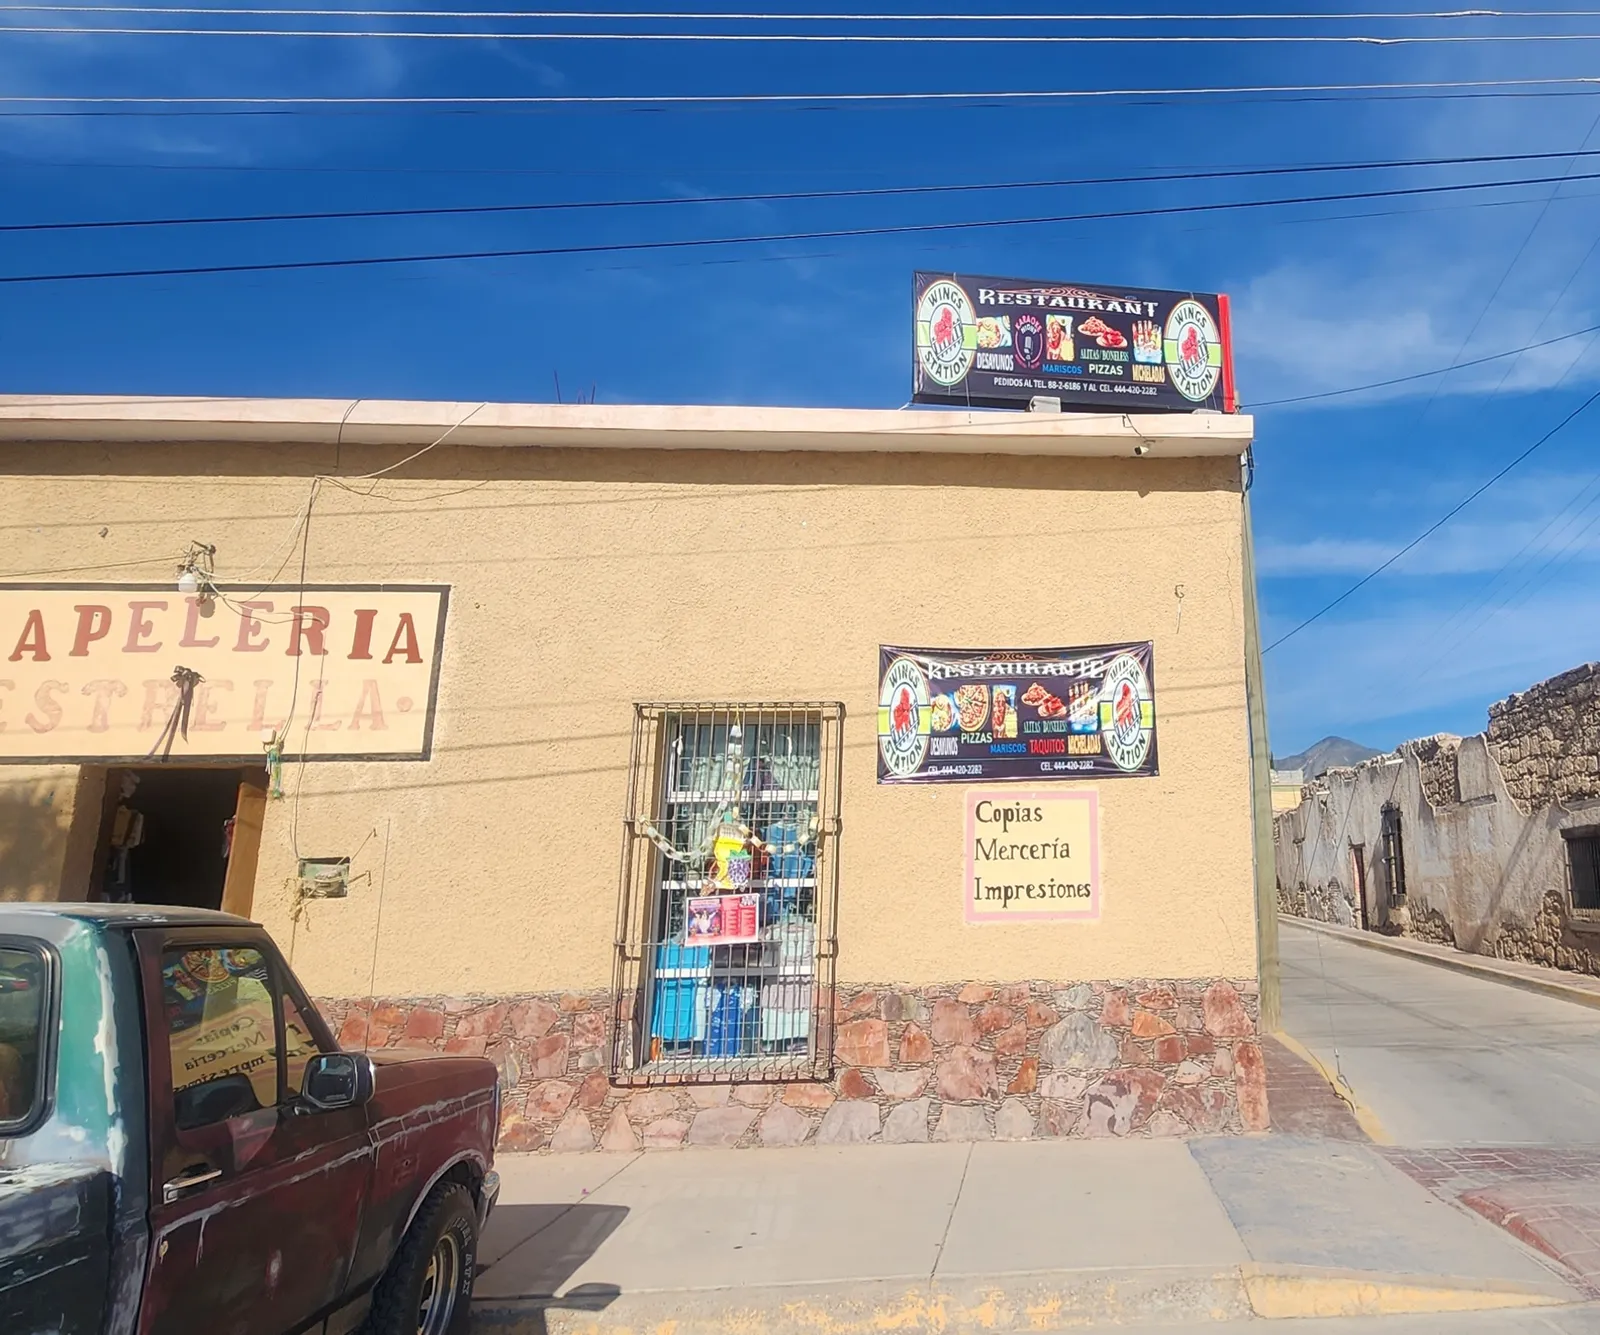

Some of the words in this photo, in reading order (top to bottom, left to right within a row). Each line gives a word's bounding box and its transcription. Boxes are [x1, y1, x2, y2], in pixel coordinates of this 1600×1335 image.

[928, 287, 964, 310] WINGS
[978, 288, 1159, 318] RESTAURANT
[1014, 315, 1043, 332] KARAOKE
[1174, 306, 1207, 328] WINGS
[925, 351, 968, 379] STATION
[977, 353, 1014, 372] DESAYUNOS
[1042, 363, 1082, 374] MARISCOS
[1088, 364, 1124, 376] PIZZAS
[1132, 364, 1166, 383] MICHELADAS
[994, 377, 1023, 387] PEDIDOS
[1024, 378, 1033, 388] AL
[1048, 380, 1081, 391] 88-2-6186
[1083, 384, 1088, 392] Y
[1088, 384, 1097, 392] AL
[1114, 386, 1158, 396] 444-420-2282
[1174, 368, 1212, 394] STATION
[8, 596, 423, 664] APELERIA
[889, 664, 920, 688] WINGS
[961, 732, 993, 744] PIZZAS
[990, 743, 1026, 754] MARISCOS
[1030, 738, 1065, 754] TAQUITOS
[1110, 734, 1146, 765] STATION
[884, 739, 923, 769] STATION
[975, 800, 1043, 833] Copias
[974, 837, 1070, 861] Mercería
[974, 876, 1091, 908] Impresiones
